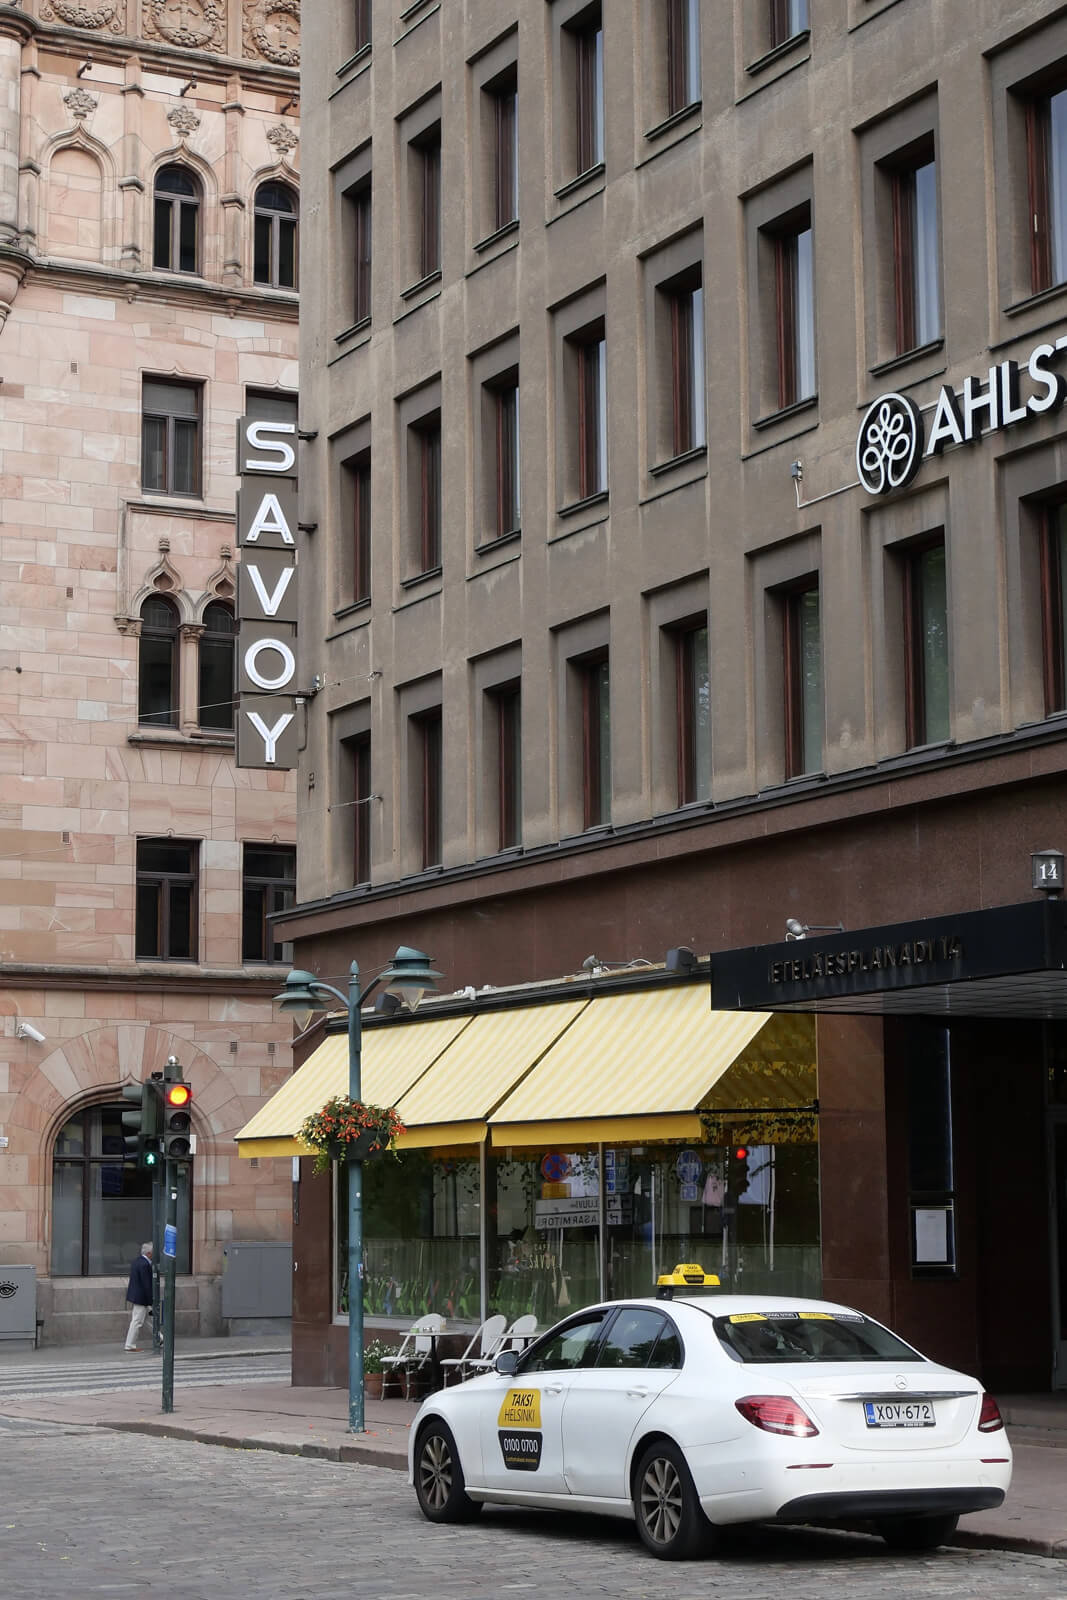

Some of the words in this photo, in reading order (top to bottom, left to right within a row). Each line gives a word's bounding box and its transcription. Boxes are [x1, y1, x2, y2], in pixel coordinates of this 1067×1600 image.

[244, 421, 296, 763] SAVOY
[1039, 863, 1058, 880] 14
[511, 1393, 535, 1407] TAKSI
[504, 1408, 535, 1422] HELSINKI
[503, 1438, 520, 1452] 0100
[520, 1439, 538, 1453] 0700
